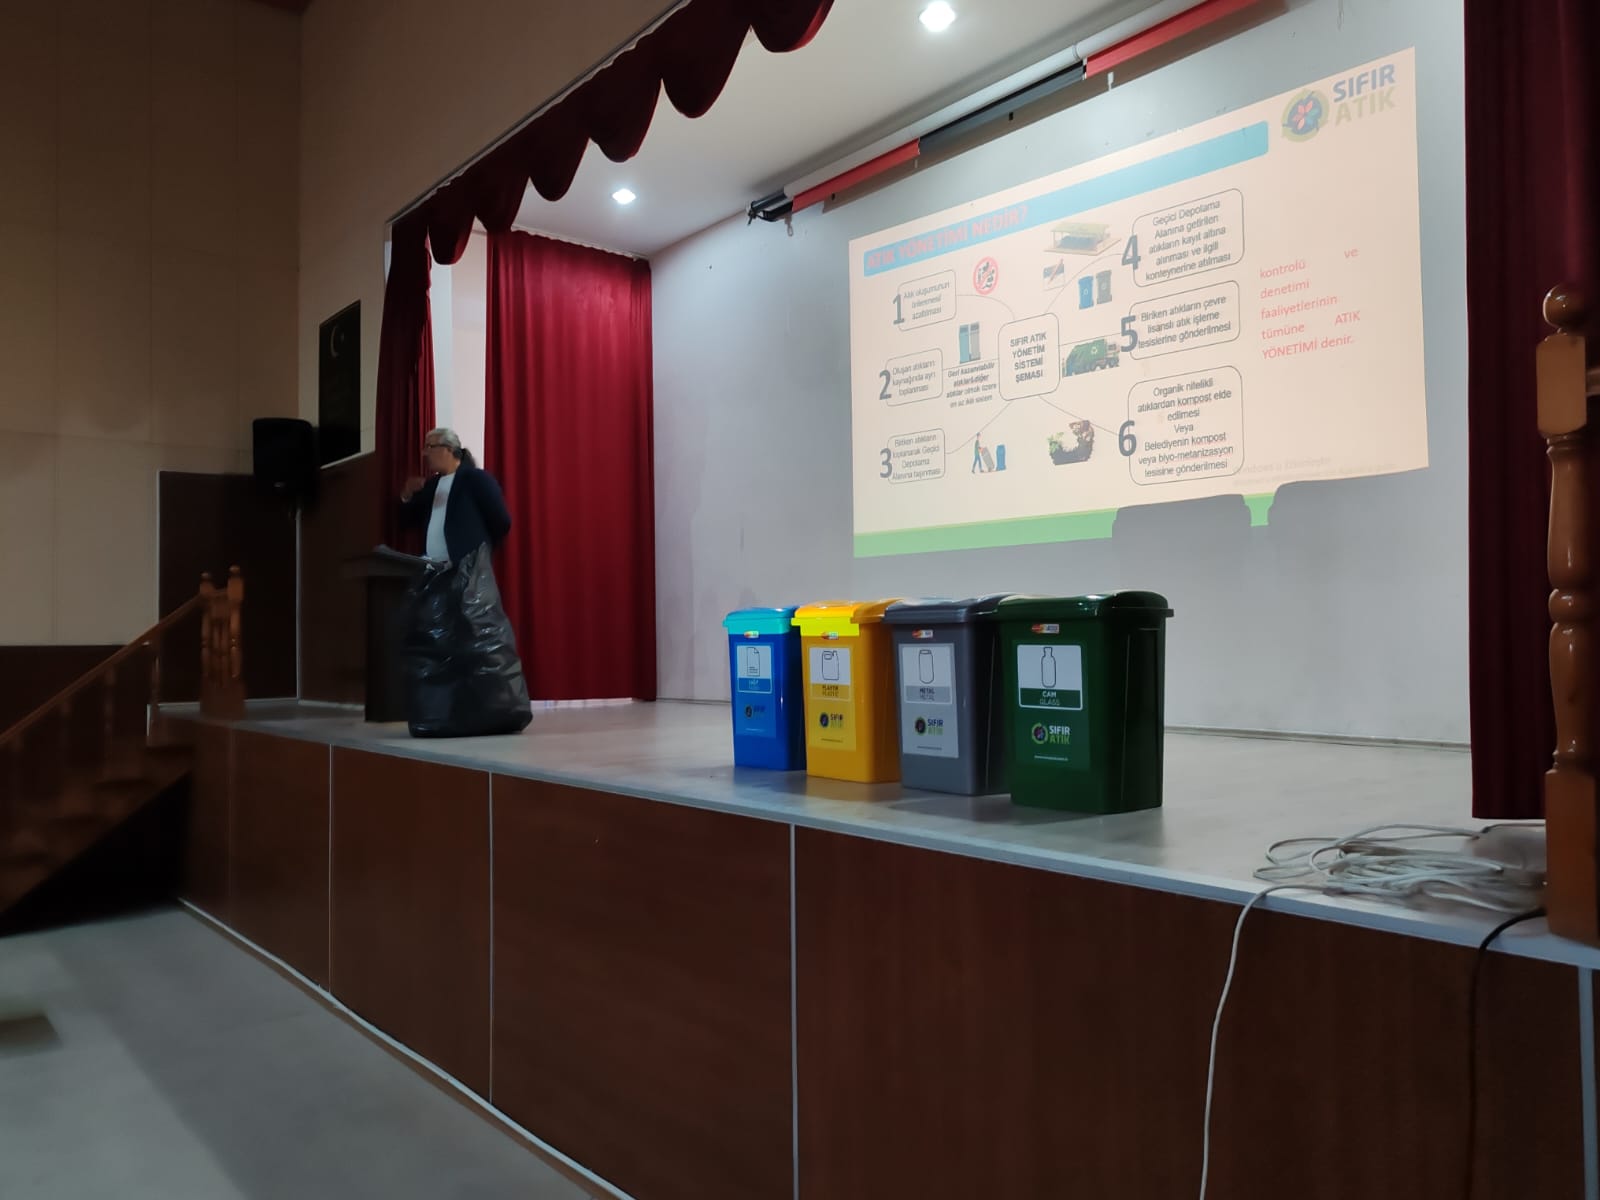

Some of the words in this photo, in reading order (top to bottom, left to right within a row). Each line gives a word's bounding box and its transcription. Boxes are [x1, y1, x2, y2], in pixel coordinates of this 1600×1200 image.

[1333, 63, 1396, 102] SIFIR
[1335, 86, 1396, 126] ATIK
[1152, 213, 1176, 226] Geçici
[1179, 200, 1220, 219] Depolama
[1121, 234, 1141, 270] 4
[1191, 246, 1202, 255] ve
[1344, 248, 1359, 259] ve
[1260, 260, 1306, 279] kontrolü
[1260, 279, 1310, 299] denetimi
[893, 294, 905, 324] 1
[1141, 309, 1168, 321] Biriken
[1204, 296, 1226, 309] çevre
[1260, 294, 1338, 320] faaliyetlerinin
[1176, 318, 1190, 328] atık
[1193, 311, 1220, 326] işleme
[1261, 323, 1305, 340] tümüne
[1334, 310, 1361, 326] ATIK
[1010, 335, 1028, 347] SIFIR
[1030, 332, 1047, 343] ATIK
[1121, 315, 1138, 352] 5
[1179, 321, 1231, 342] gönderilmesi
[1262, 338, 1318, 360] YÖNETİMİ
[1320, 334, 1353, 349] denir.
[880, 370, 892, 400] 2
[1015, 371, 1043, 384] ŞEMASI
[1153, 384, 1184, 397] Organik
[1138, 400, 1175, 413] atıklardan
[1177, 393, 1212, 406] kompost
[1213, 390, 1232, 399] elde
[1167, 409, 1200, 421] edilmesi
[1118, 420, 1137, 457] 6
[1174, 424, 1194, 434] Veya
[1145, 438, 1189, 451] Belediyenin
[1192, 432, 1226, 446] kompost
[880, 448, 893, 478] 3
[1138, 455, 1156, 465] veya
[1176, 460, 1228, 476] gönderilmesi
[927, 719, 943, 727] SIFIR
[1049, 725, 1070, 735] SIFIR
[1049, 735, 1070, 745] ATIK
